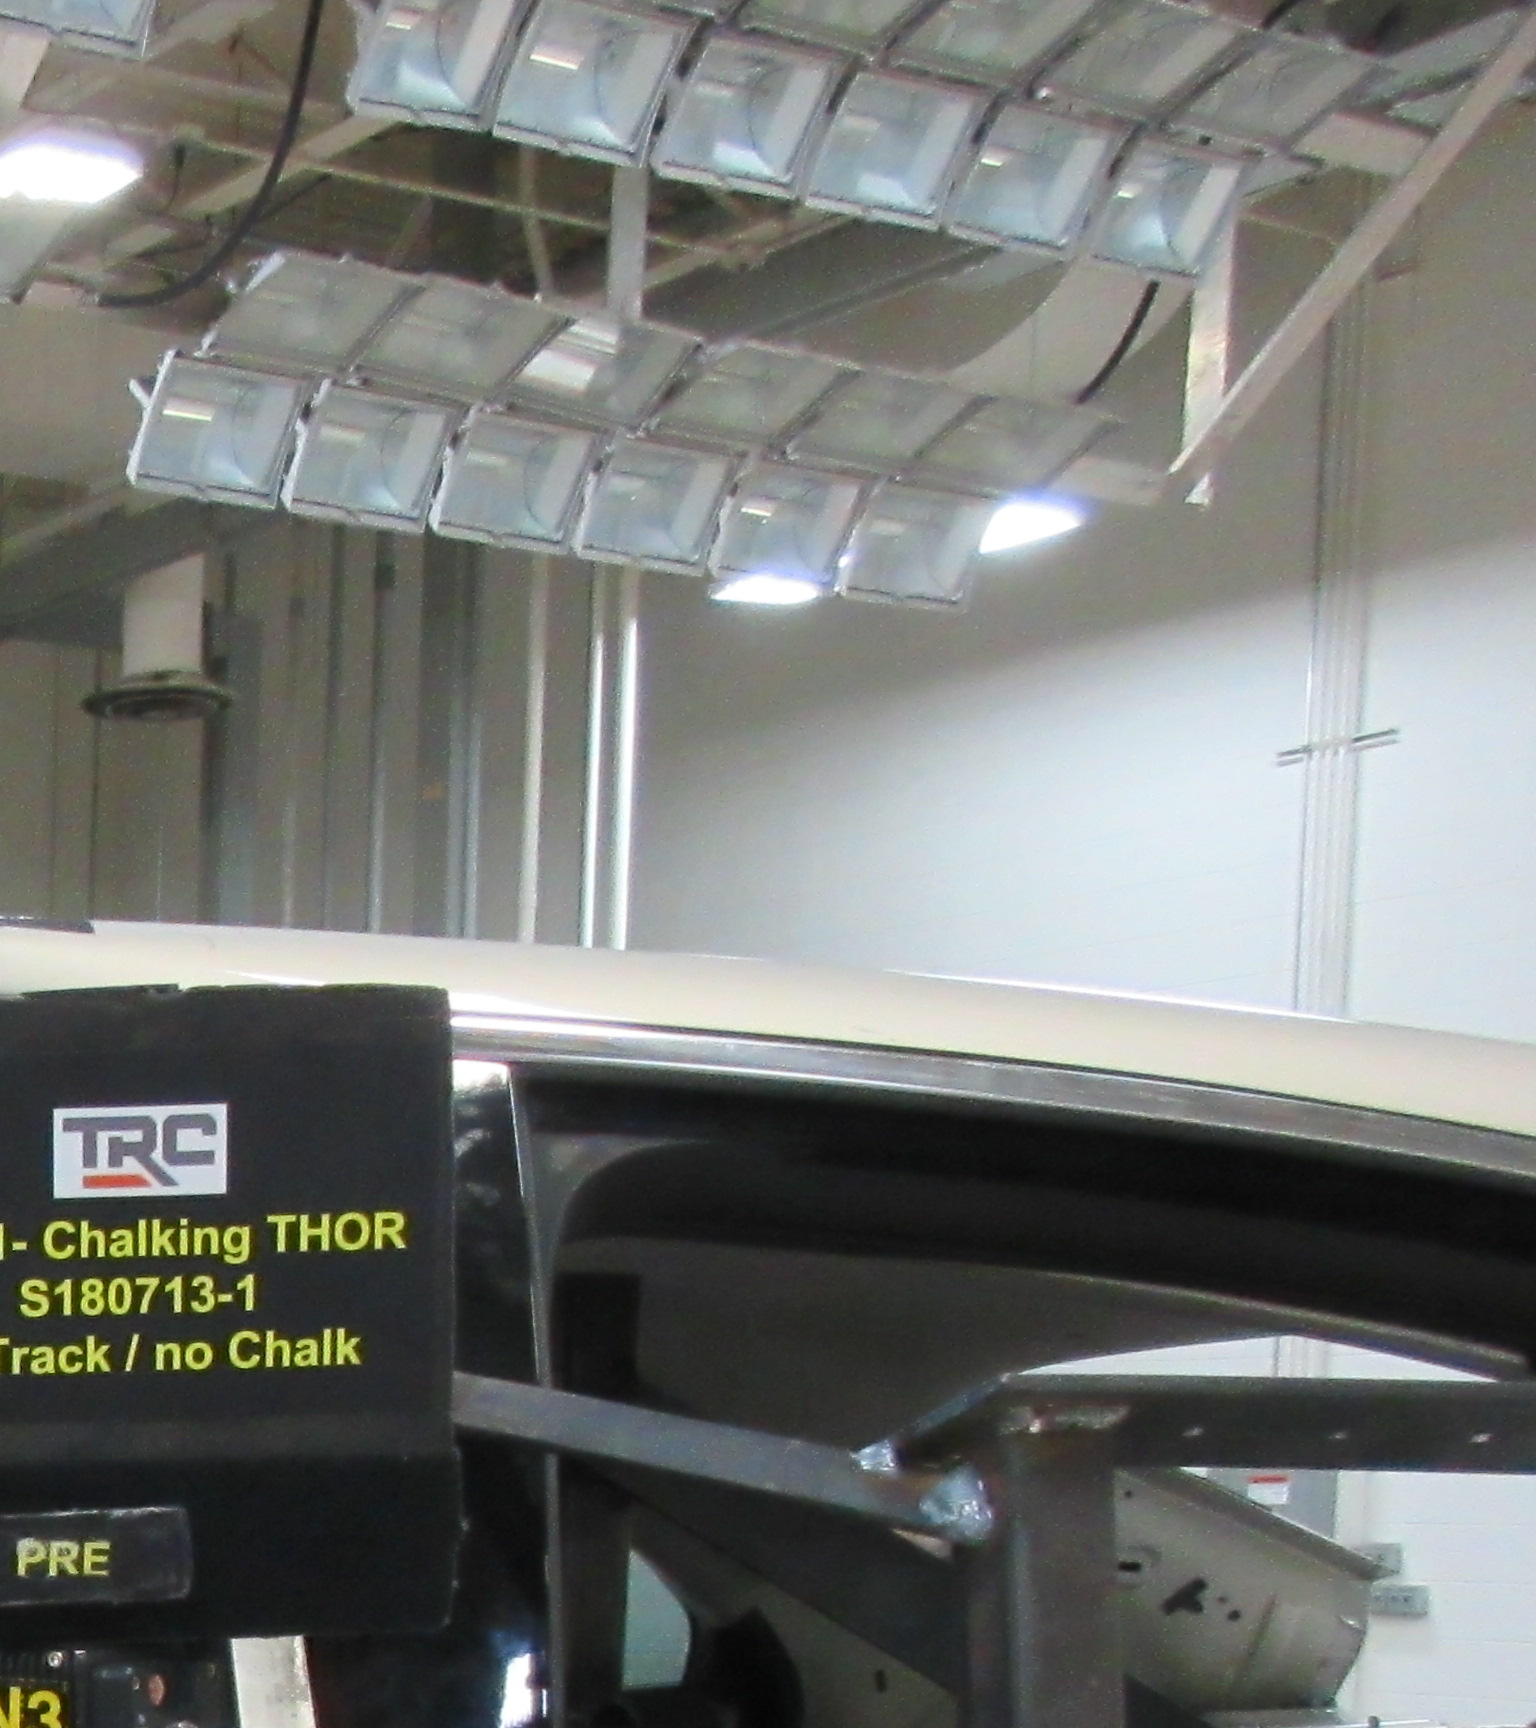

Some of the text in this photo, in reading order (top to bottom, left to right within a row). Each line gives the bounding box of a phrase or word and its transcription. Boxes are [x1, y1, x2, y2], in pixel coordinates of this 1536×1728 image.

[62, 1112, 218, 1187] TRC
[42, 1217, 251, 1265] Chalking
[266, 1210, 407, 1254] THOR
[19, 1273, 257, 1319] S180713-1
[124, 1333, 140, 1373] /
[154, 1342, 214, 1371] no
[228, 1327, 362, 1370] Chalk
[15, 1537, 112, 1578] PRE
